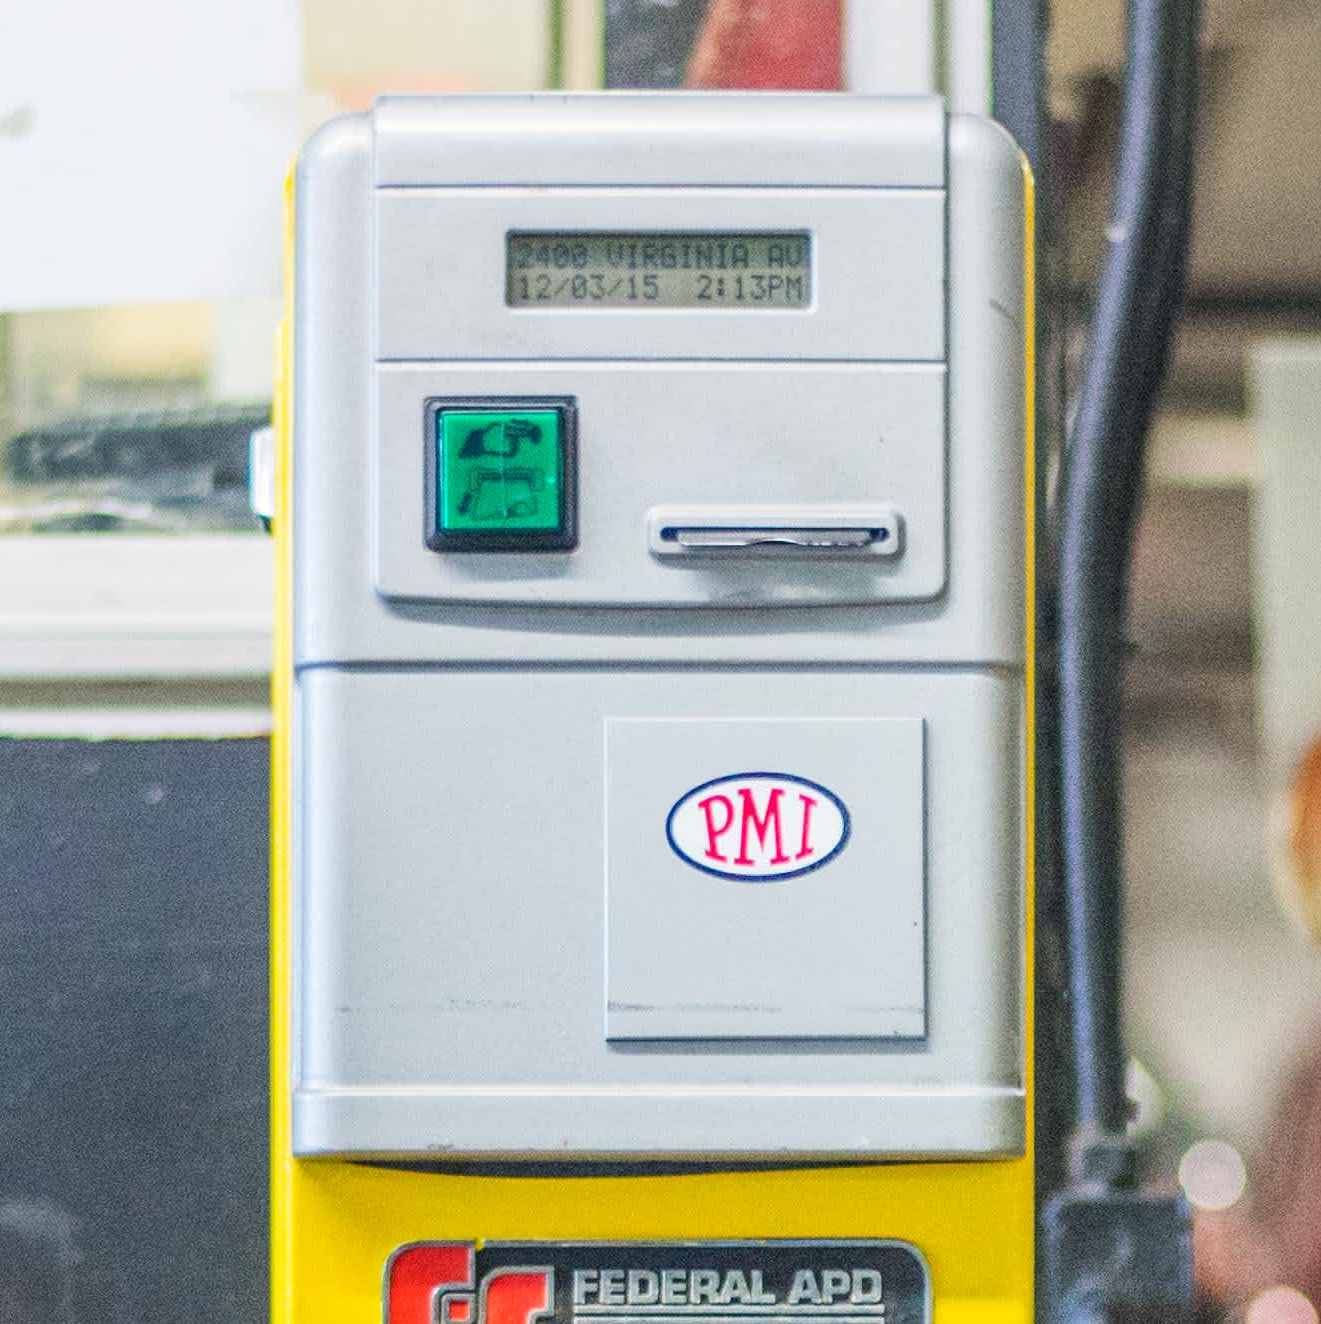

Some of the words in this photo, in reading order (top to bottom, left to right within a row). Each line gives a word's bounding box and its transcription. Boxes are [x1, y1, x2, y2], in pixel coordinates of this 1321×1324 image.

[517, 244, 588, 269] 2400
[607, 244, 749, 269] VIRGINIA
[519, 273, 660, 301] 12/03/15
[696, 273, 803, 301] 2:13PM
[698, 787, 817, 866] PMI
[574, 1269, 776, 1305] FEDERAL
[788, 1269, 883, 1305] APD
